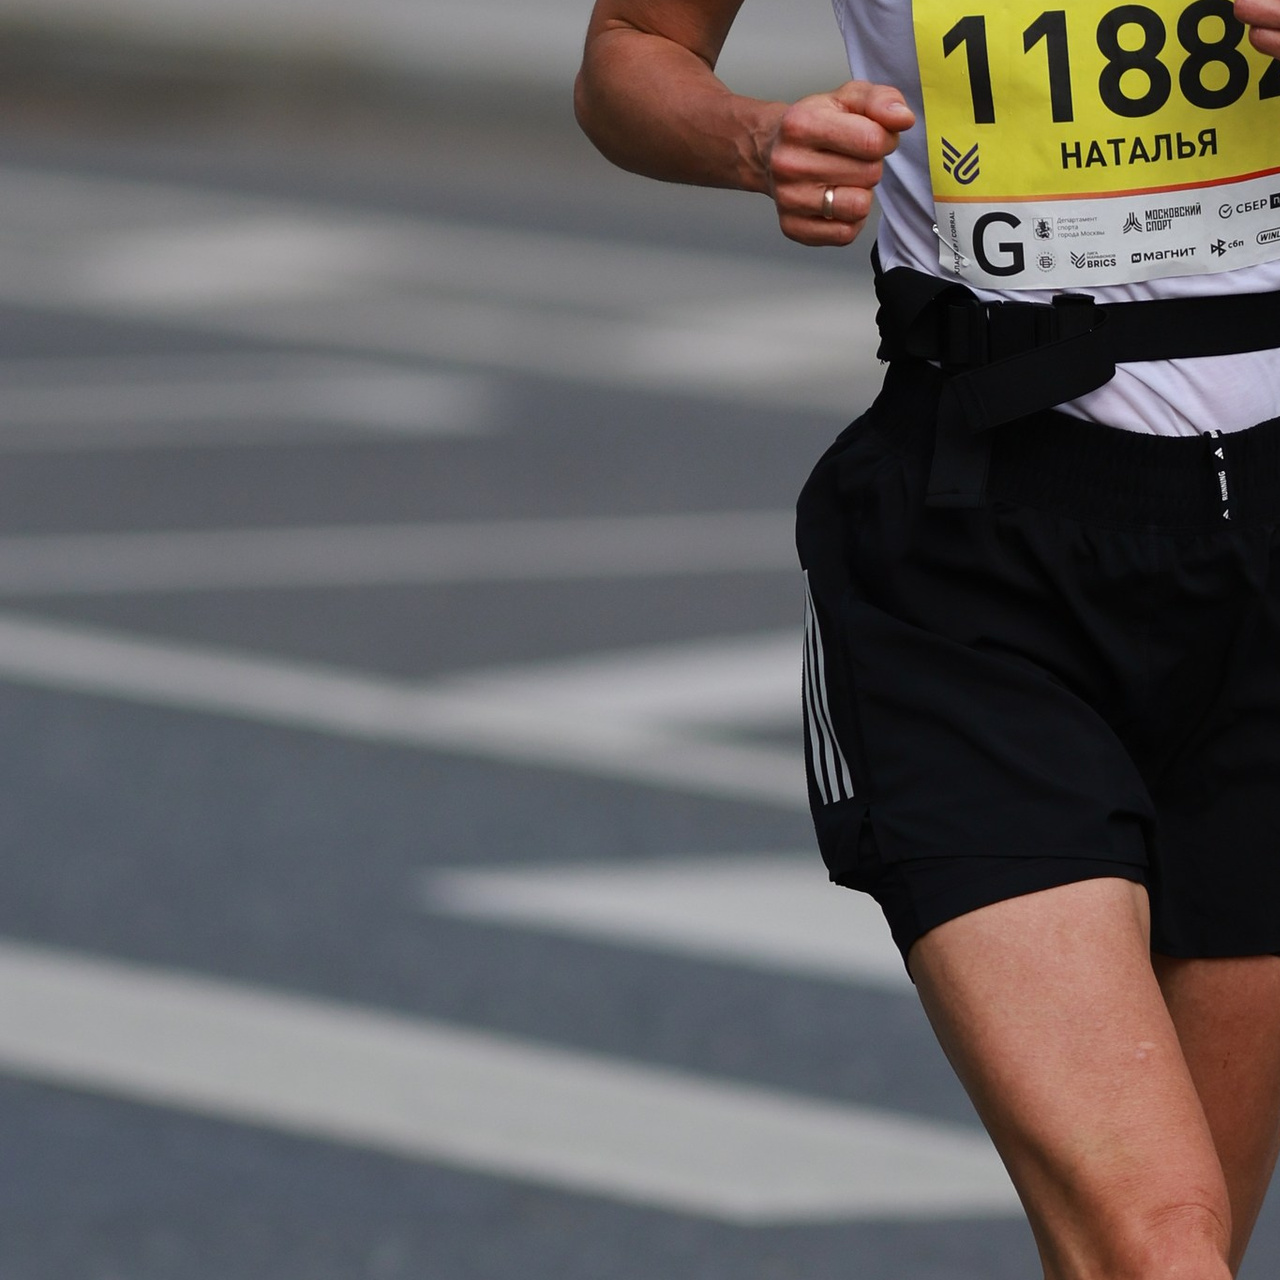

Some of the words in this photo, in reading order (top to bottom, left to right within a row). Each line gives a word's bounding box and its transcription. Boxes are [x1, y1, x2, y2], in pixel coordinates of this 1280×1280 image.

[1060, 128, 1218, 170] НАТАЛЬЯ
[1145, 202, 1202, 220] МОСКОВСКИЙ
[1235, 199, 1268, 214] СБЕР
[949, 211, 957, 238] CORRAL
[1057, 216, 1097, 224] Департамент
[1145, 219, 1172, 232] СПОРТ
[972, 212, 1025, 276] G
[1228, 239, 1244, 248] сбп
[1087, 258, 1117, 268] BRICS
[1218, 470, 1228, 501] RUNNING
